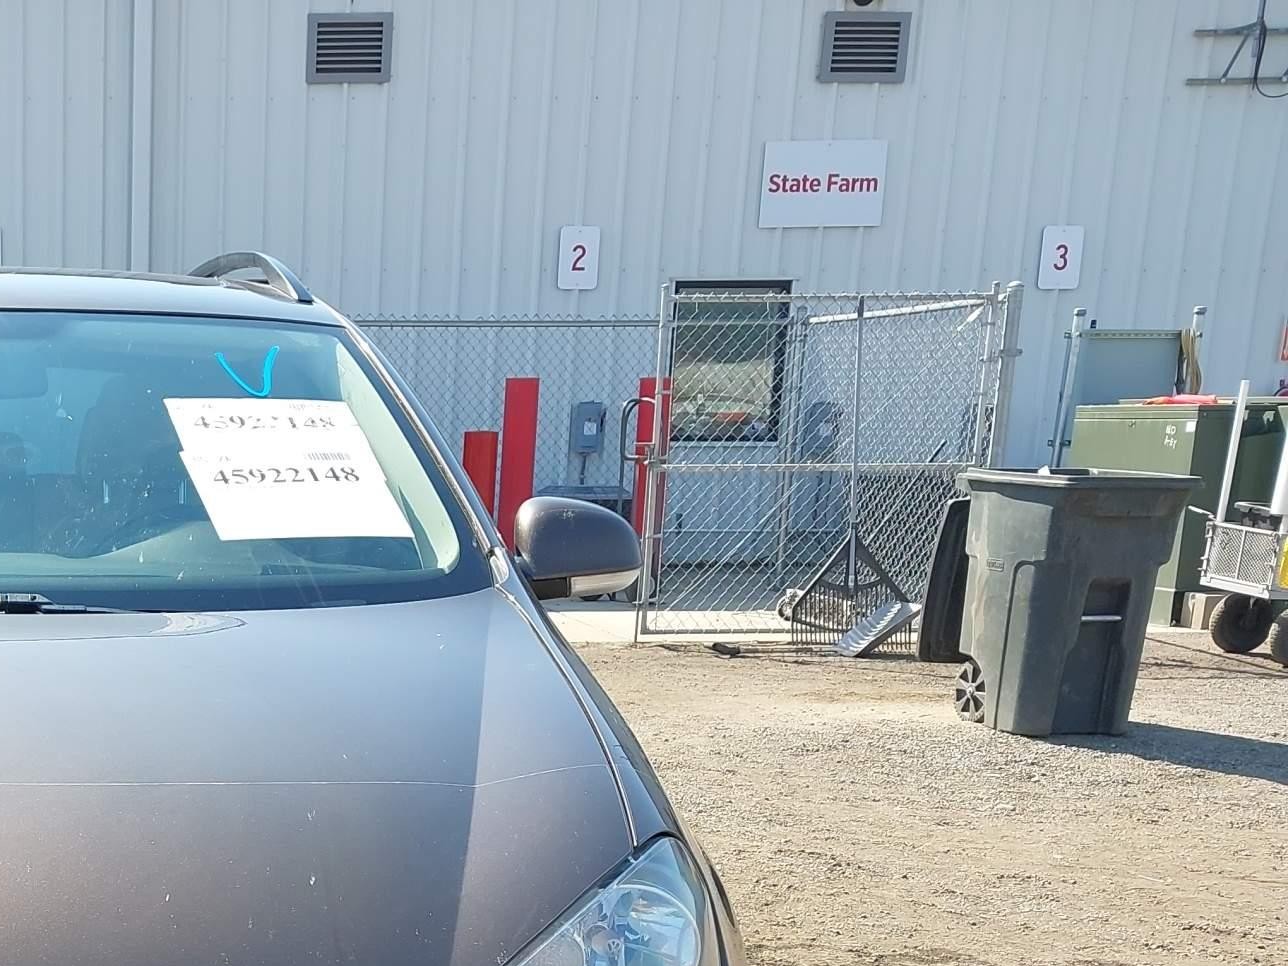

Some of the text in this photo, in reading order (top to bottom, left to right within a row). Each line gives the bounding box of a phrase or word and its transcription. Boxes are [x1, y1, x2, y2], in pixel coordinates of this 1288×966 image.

[768, 173, 878, 193] State Farm
[571, 244, 587, 271] 2
[1053, 243, 1069, 271] 3
[213, 466, 361, 486] 45922148
